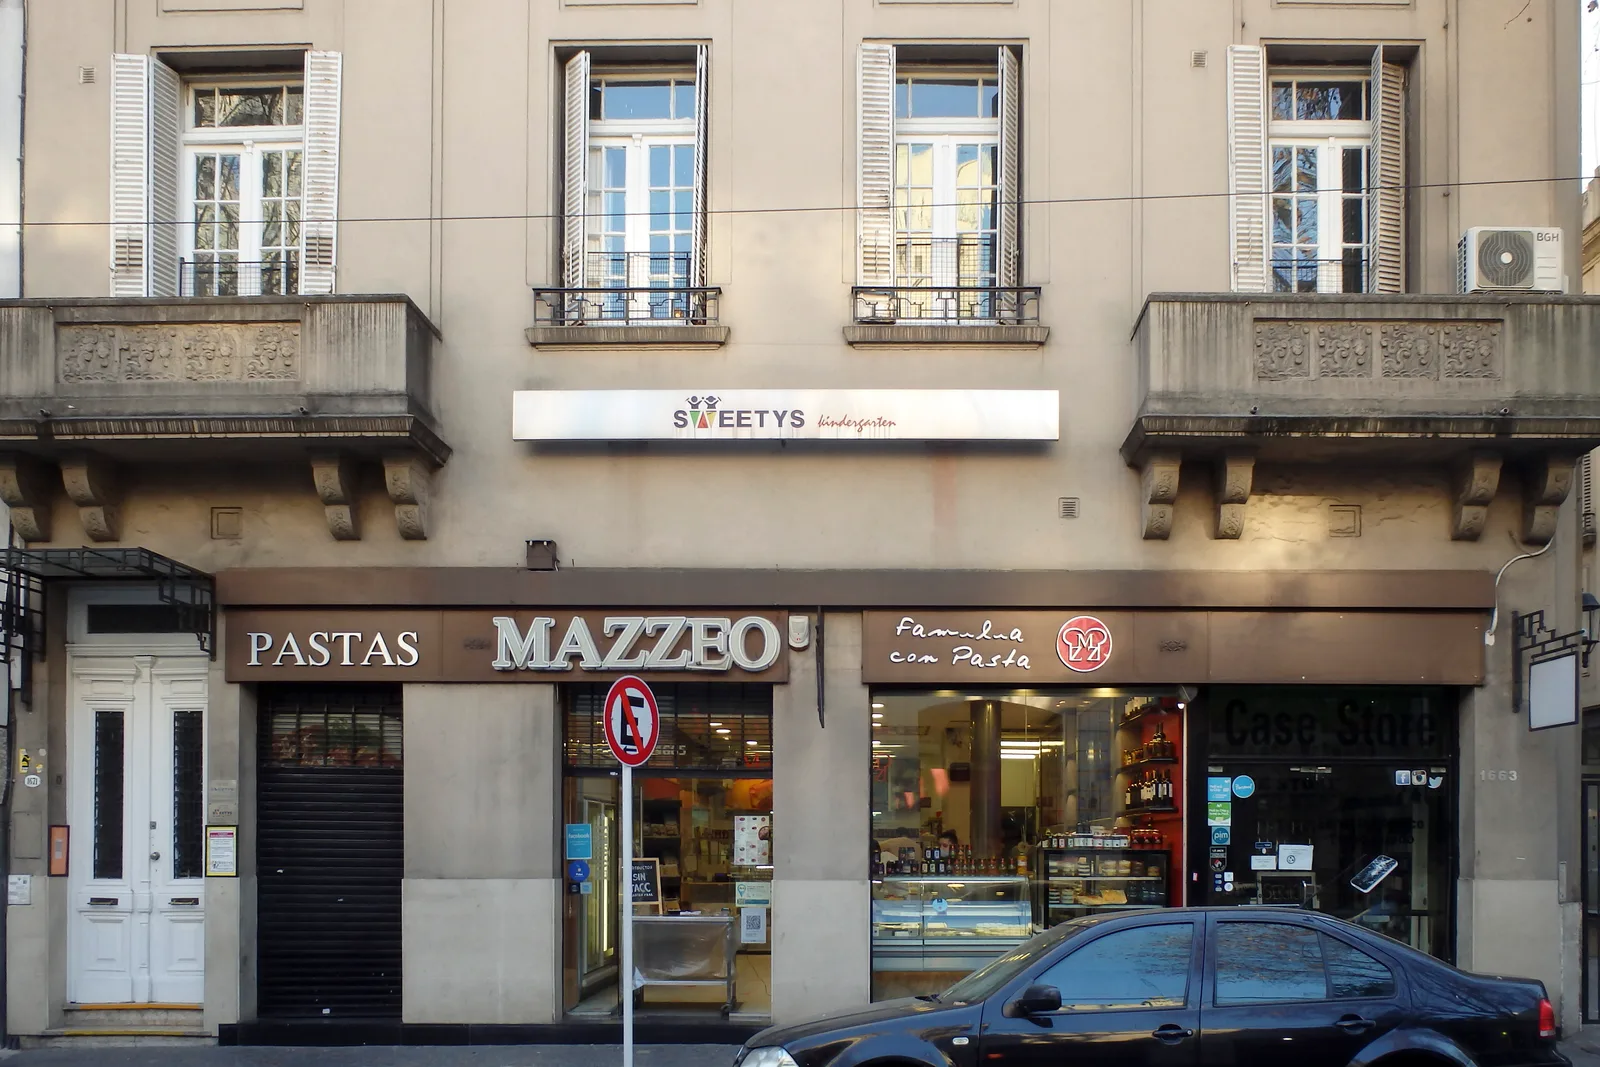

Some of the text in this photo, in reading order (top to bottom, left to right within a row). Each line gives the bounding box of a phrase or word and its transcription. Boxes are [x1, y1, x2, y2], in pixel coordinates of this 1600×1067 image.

[1537, 232, 1559, 242] BGH
[673, 408, 897, 433] SWEETYS kindergarten
[247, 631, 420, 668] PASTAS
[491, 616, 782, 672] MAZZEO
[890, 645, 1031, 670] con Pasta
[620, 695, 645, 746] E
[1225, 698, 1437, 748] Case Store
[1480, 769, 1518, 781] 1663
[632, 873, 647, 881] SIN
